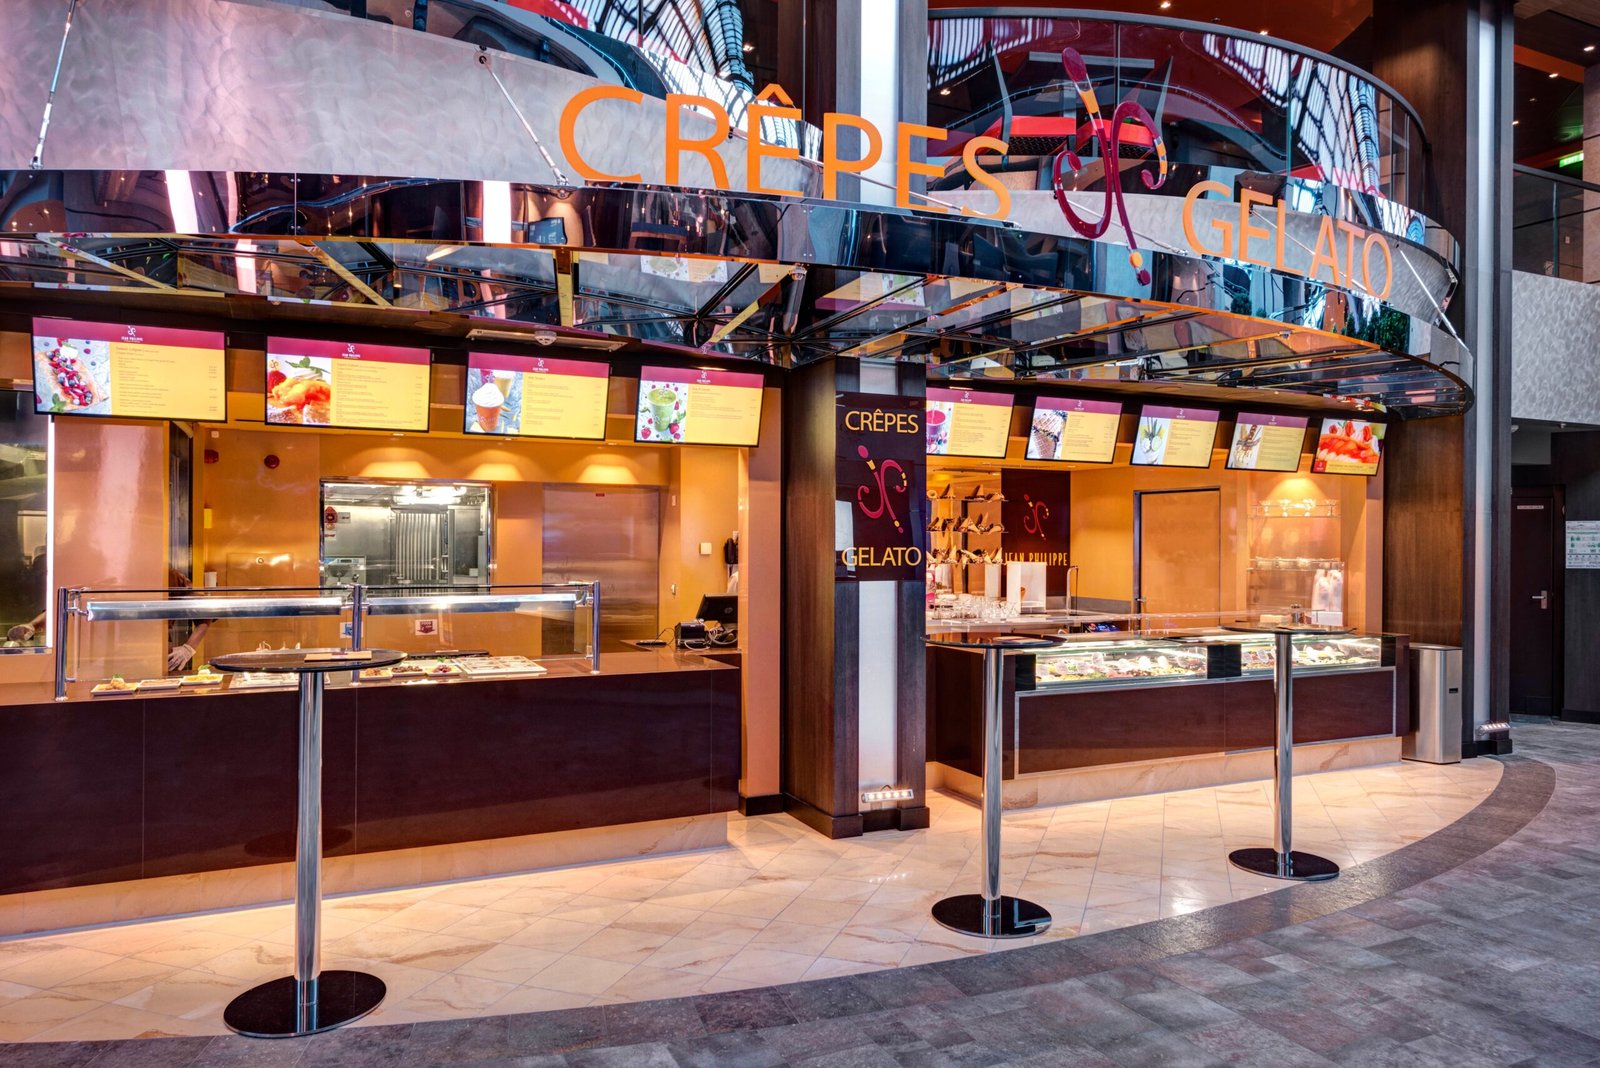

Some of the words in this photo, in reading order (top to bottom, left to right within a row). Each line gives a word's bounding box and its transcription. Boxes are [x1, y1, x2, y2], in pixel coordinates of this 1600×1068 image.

[558, 83, 1012, 220] CRÊPES
[1182, 180, 1393, 299] GELATO
[844, 409, 919, 434] CRÊPES
[842, 546, 922, 567] GELATO
